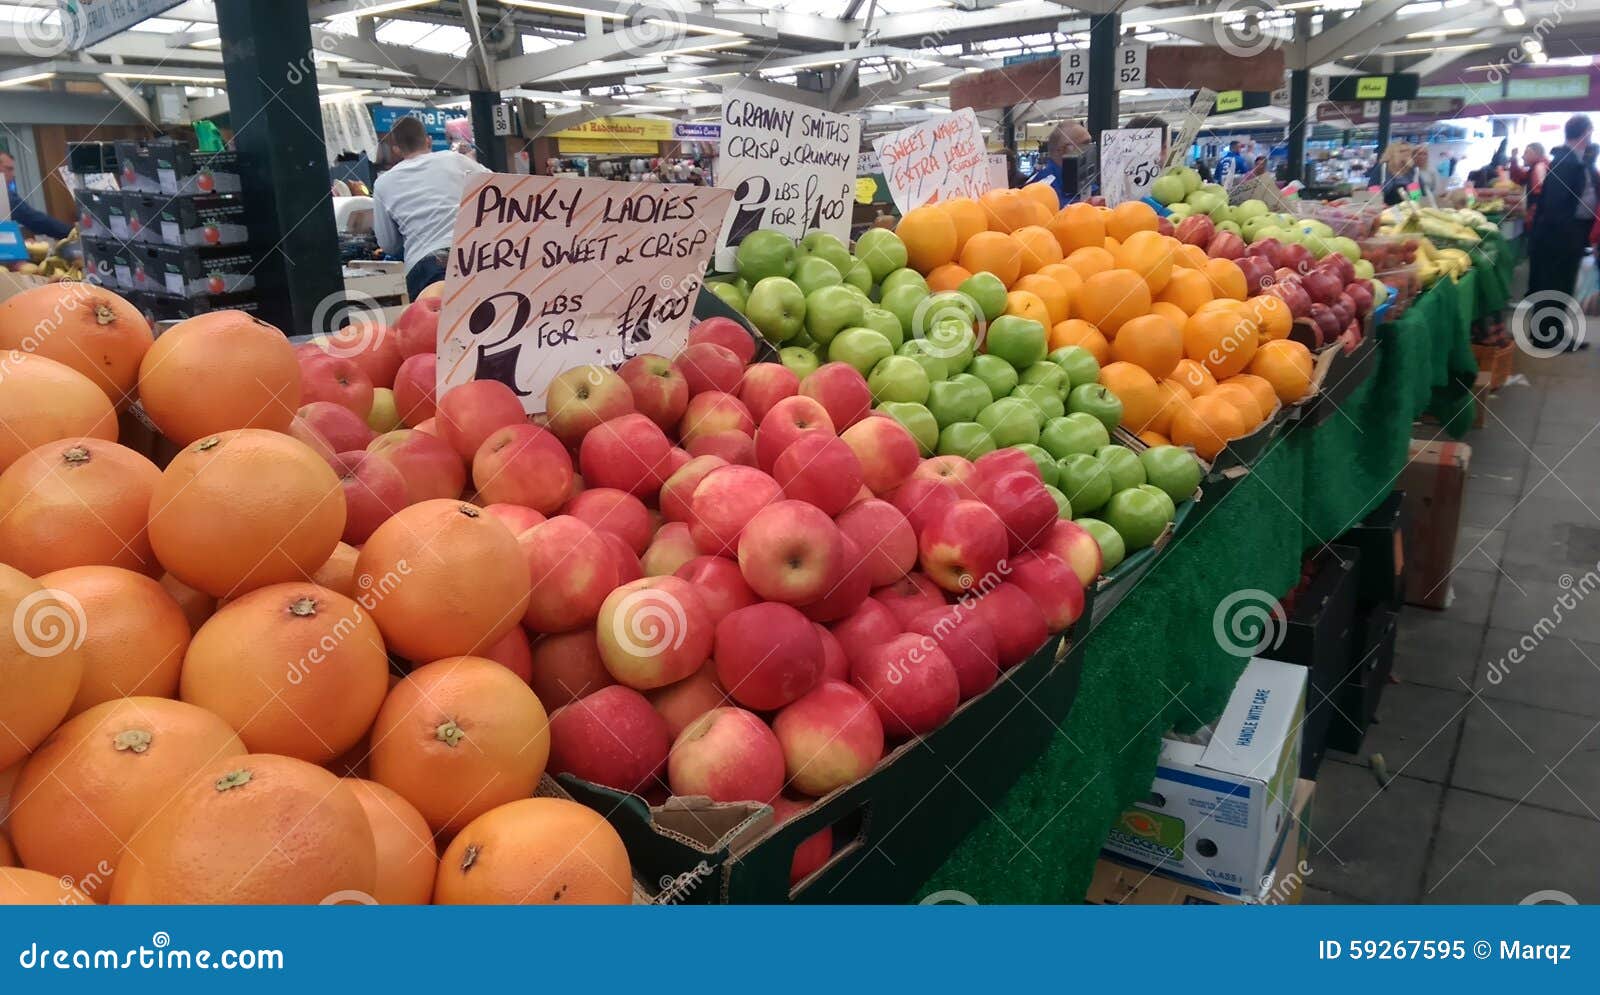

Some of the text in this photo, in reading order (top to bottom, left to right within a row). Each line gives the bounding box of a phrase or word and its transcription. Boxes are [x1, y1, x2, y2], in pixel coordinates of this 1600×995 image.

[1069, 54, 1081, 68] B
[1120, 66, 1141, 82] 52
[1124, 49, 1136, 65] B
[1065, 71, 1085, 86] 47
[726, 99, 849, 143] GRANNY SMITHS
[728, 135, 779, 159] CRISP
[794, 145, 850, 171] CRUNCHY
[882, 129, 927, 165] SWEET
[895, 155, 940, 191] EXTRA
[475, 184, 698, 228] PINKY LADIES
[725, 175, 771, 247] 2
[774, 182, 800, 201] LBS
[770, 207, 797, 226] FOR
[456, 237, 530, 278] VERY
[542, 233, 617, 269] SWEET
[639, 229, 708, 259] CRISP
[468, 291, 533, 397] 2
[541, 293, 584, 317] LBS
[537, 318, 579, 349] FOR
[1234, 688, 1272, 746] HANDLE WITH CARE
[1206, 868, 1238, 882] CLASS
